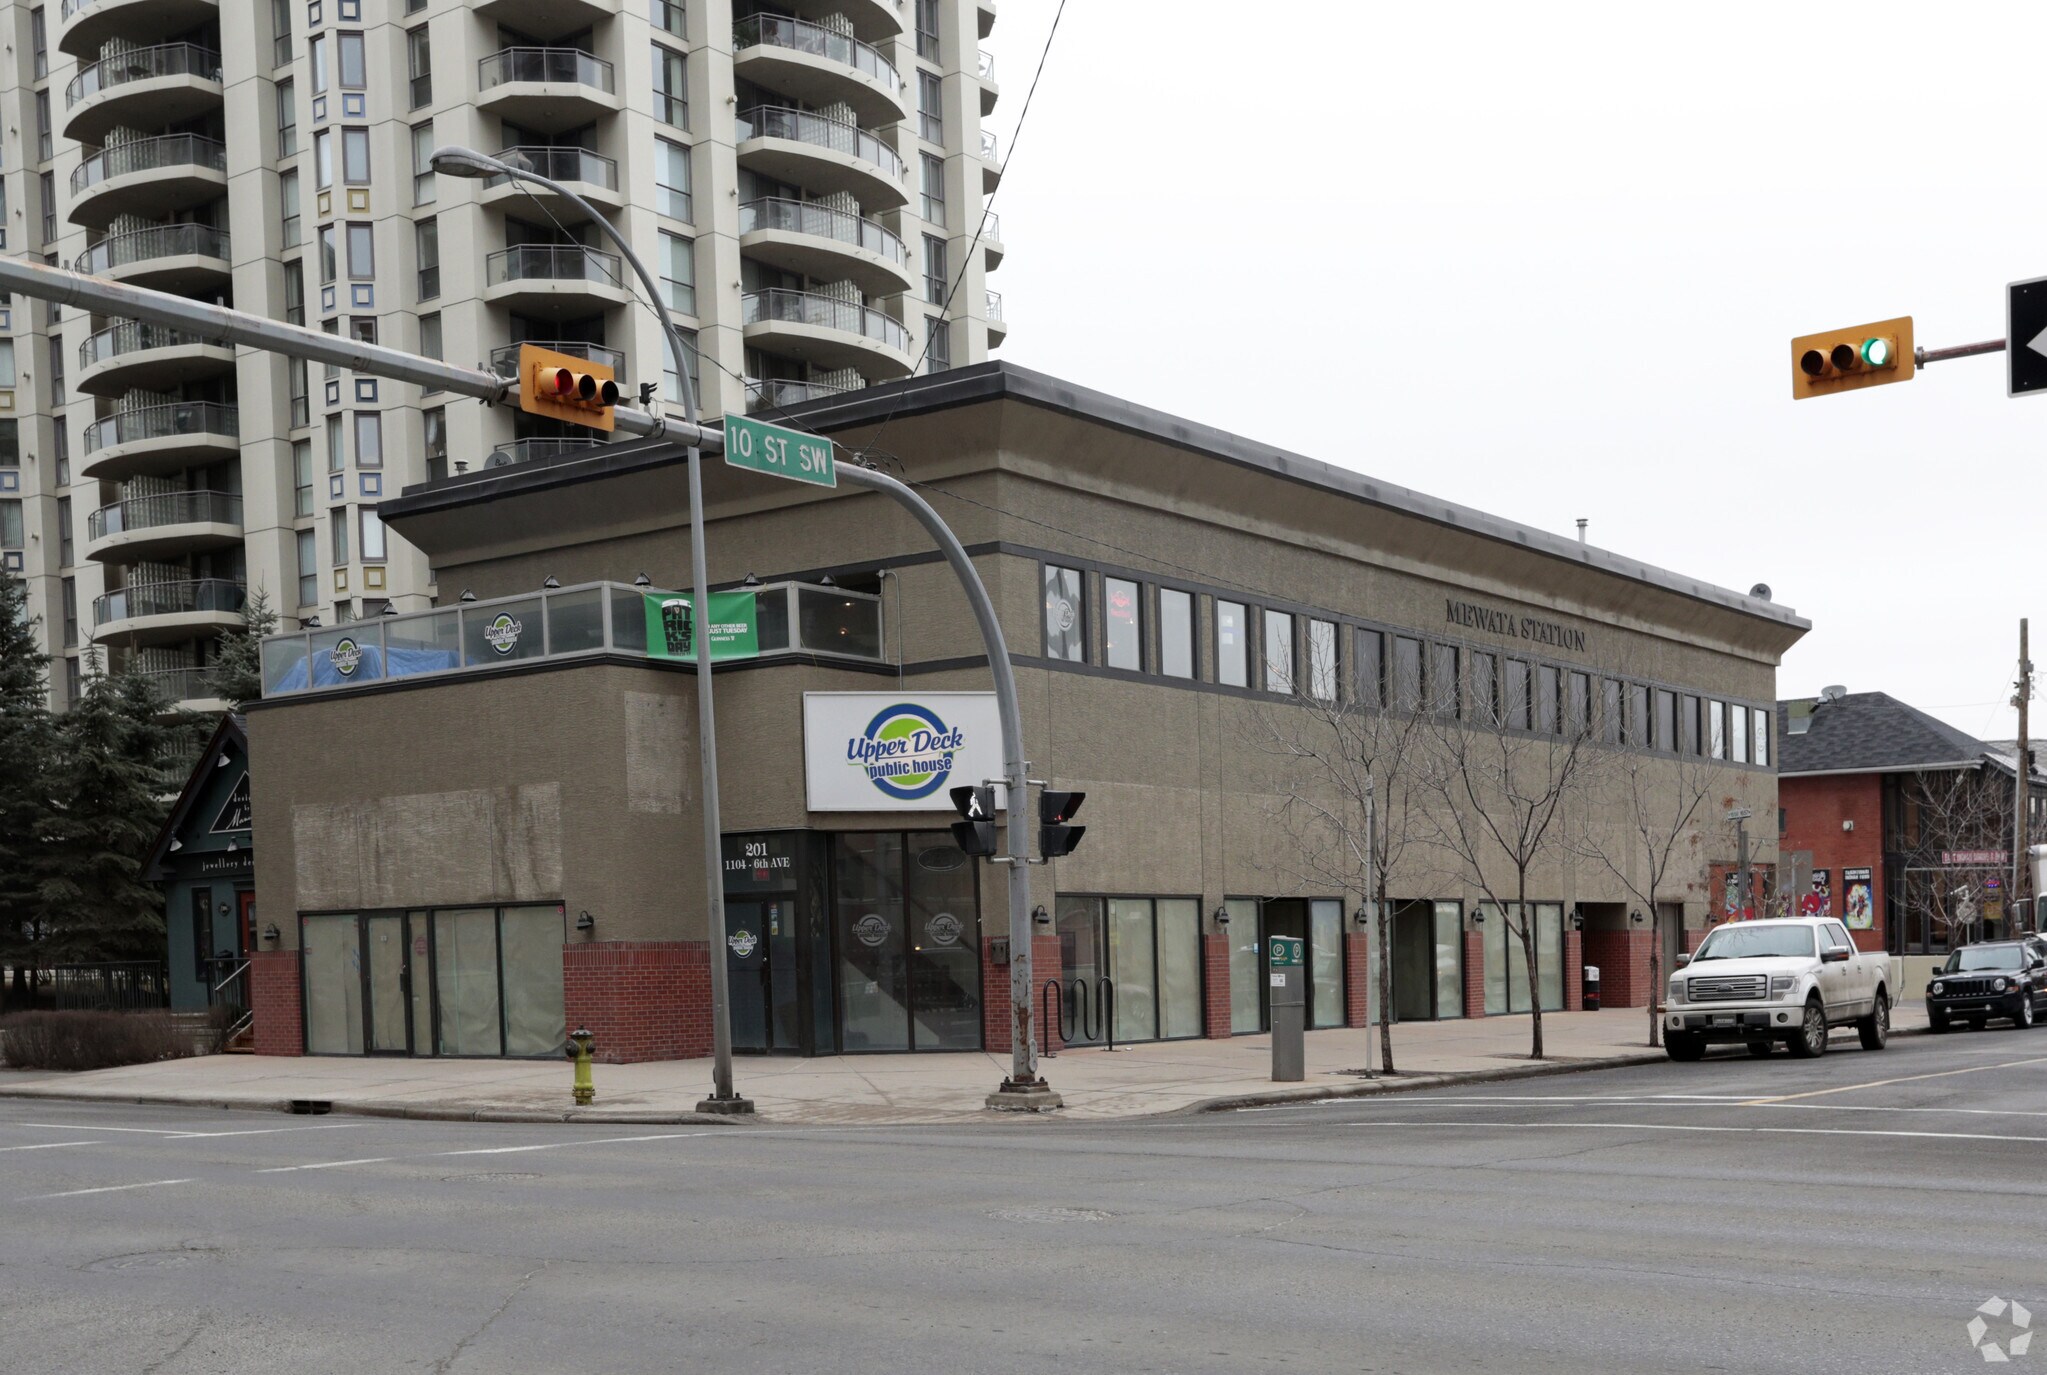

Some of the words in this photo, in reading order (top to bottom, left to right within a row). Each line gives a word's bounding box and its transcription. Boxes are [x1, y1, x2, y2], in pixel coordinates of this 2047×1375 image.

[730, 426, 752, 458] 10
[764, 435, 788, 466] ST
[799, 444, 827, 475] SW
[1446, 599, 1518, 638] MEWATA
[1520, 617, 1585, 652] STATION
[847, 738, 908, 764] Upper
[911, 727, 963, 753] Deck
[869, 761, 910, 779] public
[912, 758, 952, 773] house
[745, 843, 768, 857] 201
[202, 858, 238, 871] jewellery
[726, 859, 746, 870] 1104
[753, 858, 768, 868] 6th
[770, 857, 790, 868] AVE
